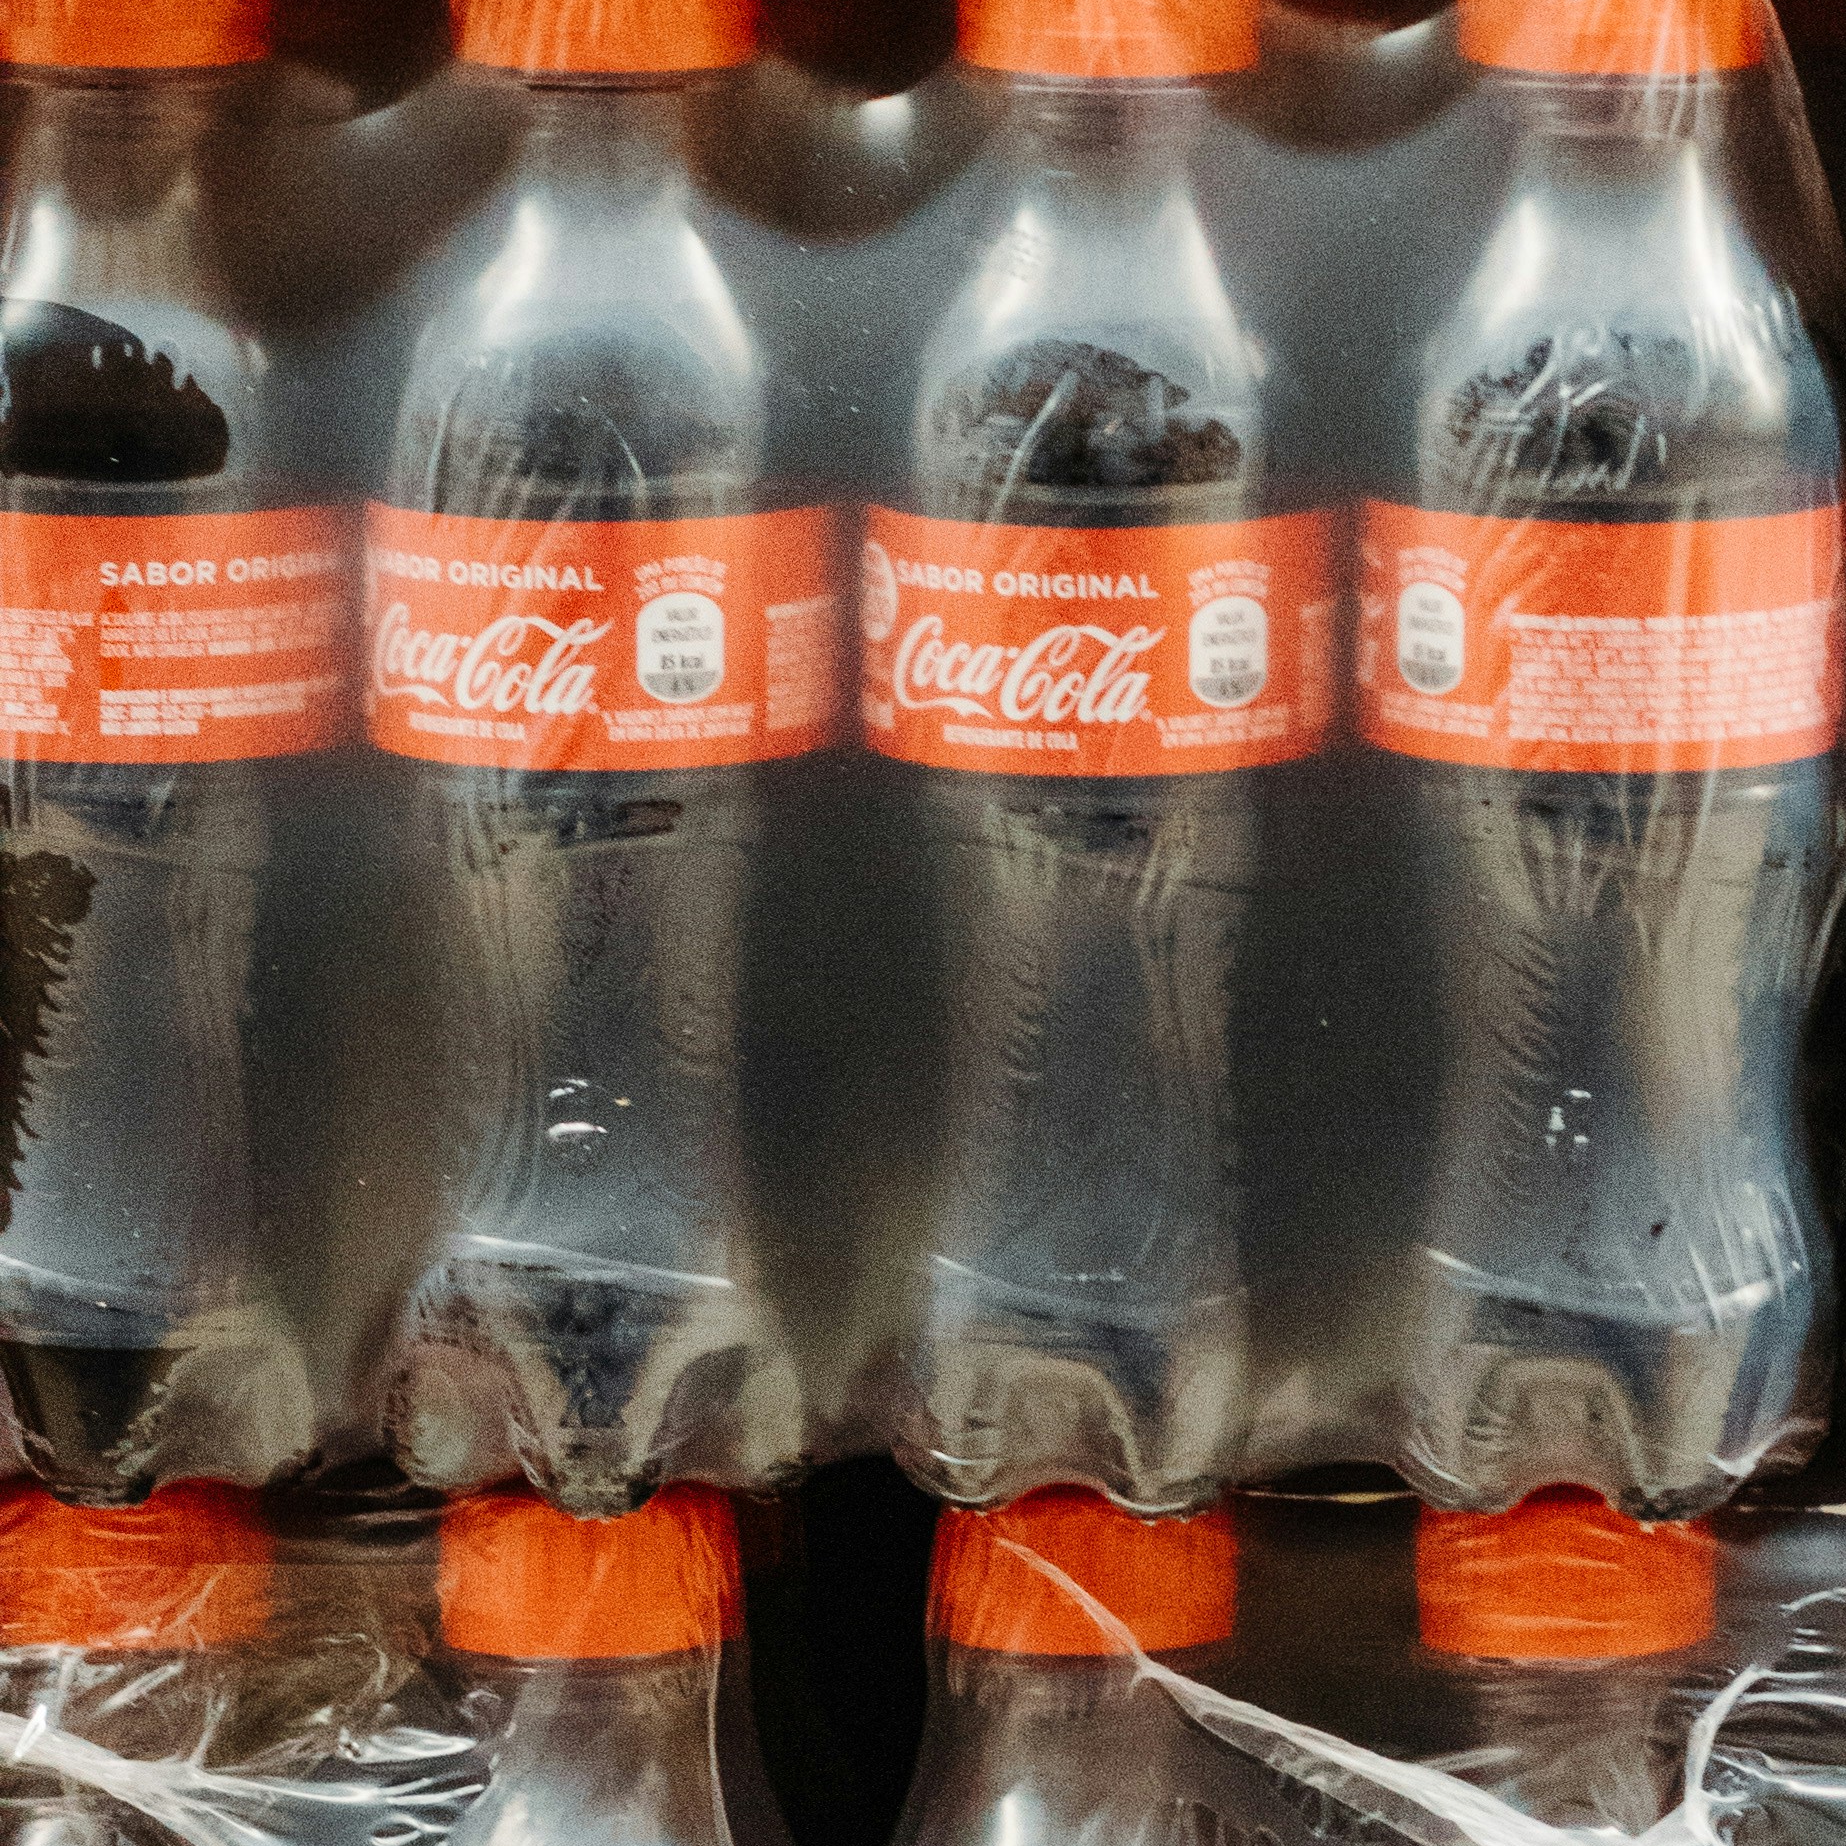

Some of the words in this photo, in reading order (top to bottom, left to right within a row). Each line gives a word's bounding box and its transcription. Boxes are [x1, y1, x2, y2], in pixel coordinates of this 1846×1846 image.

[100, 560, 217, 586] SABOR
[447, 560, 604, 592] ORIGINAL
[898, 560, 984, 596] SABOR
[993, 571, 1159, 599] ORIGINAL
[376, 601, 613, 715] Coca-Cola
[893, 614, 1166, 723] Coca-Cola
